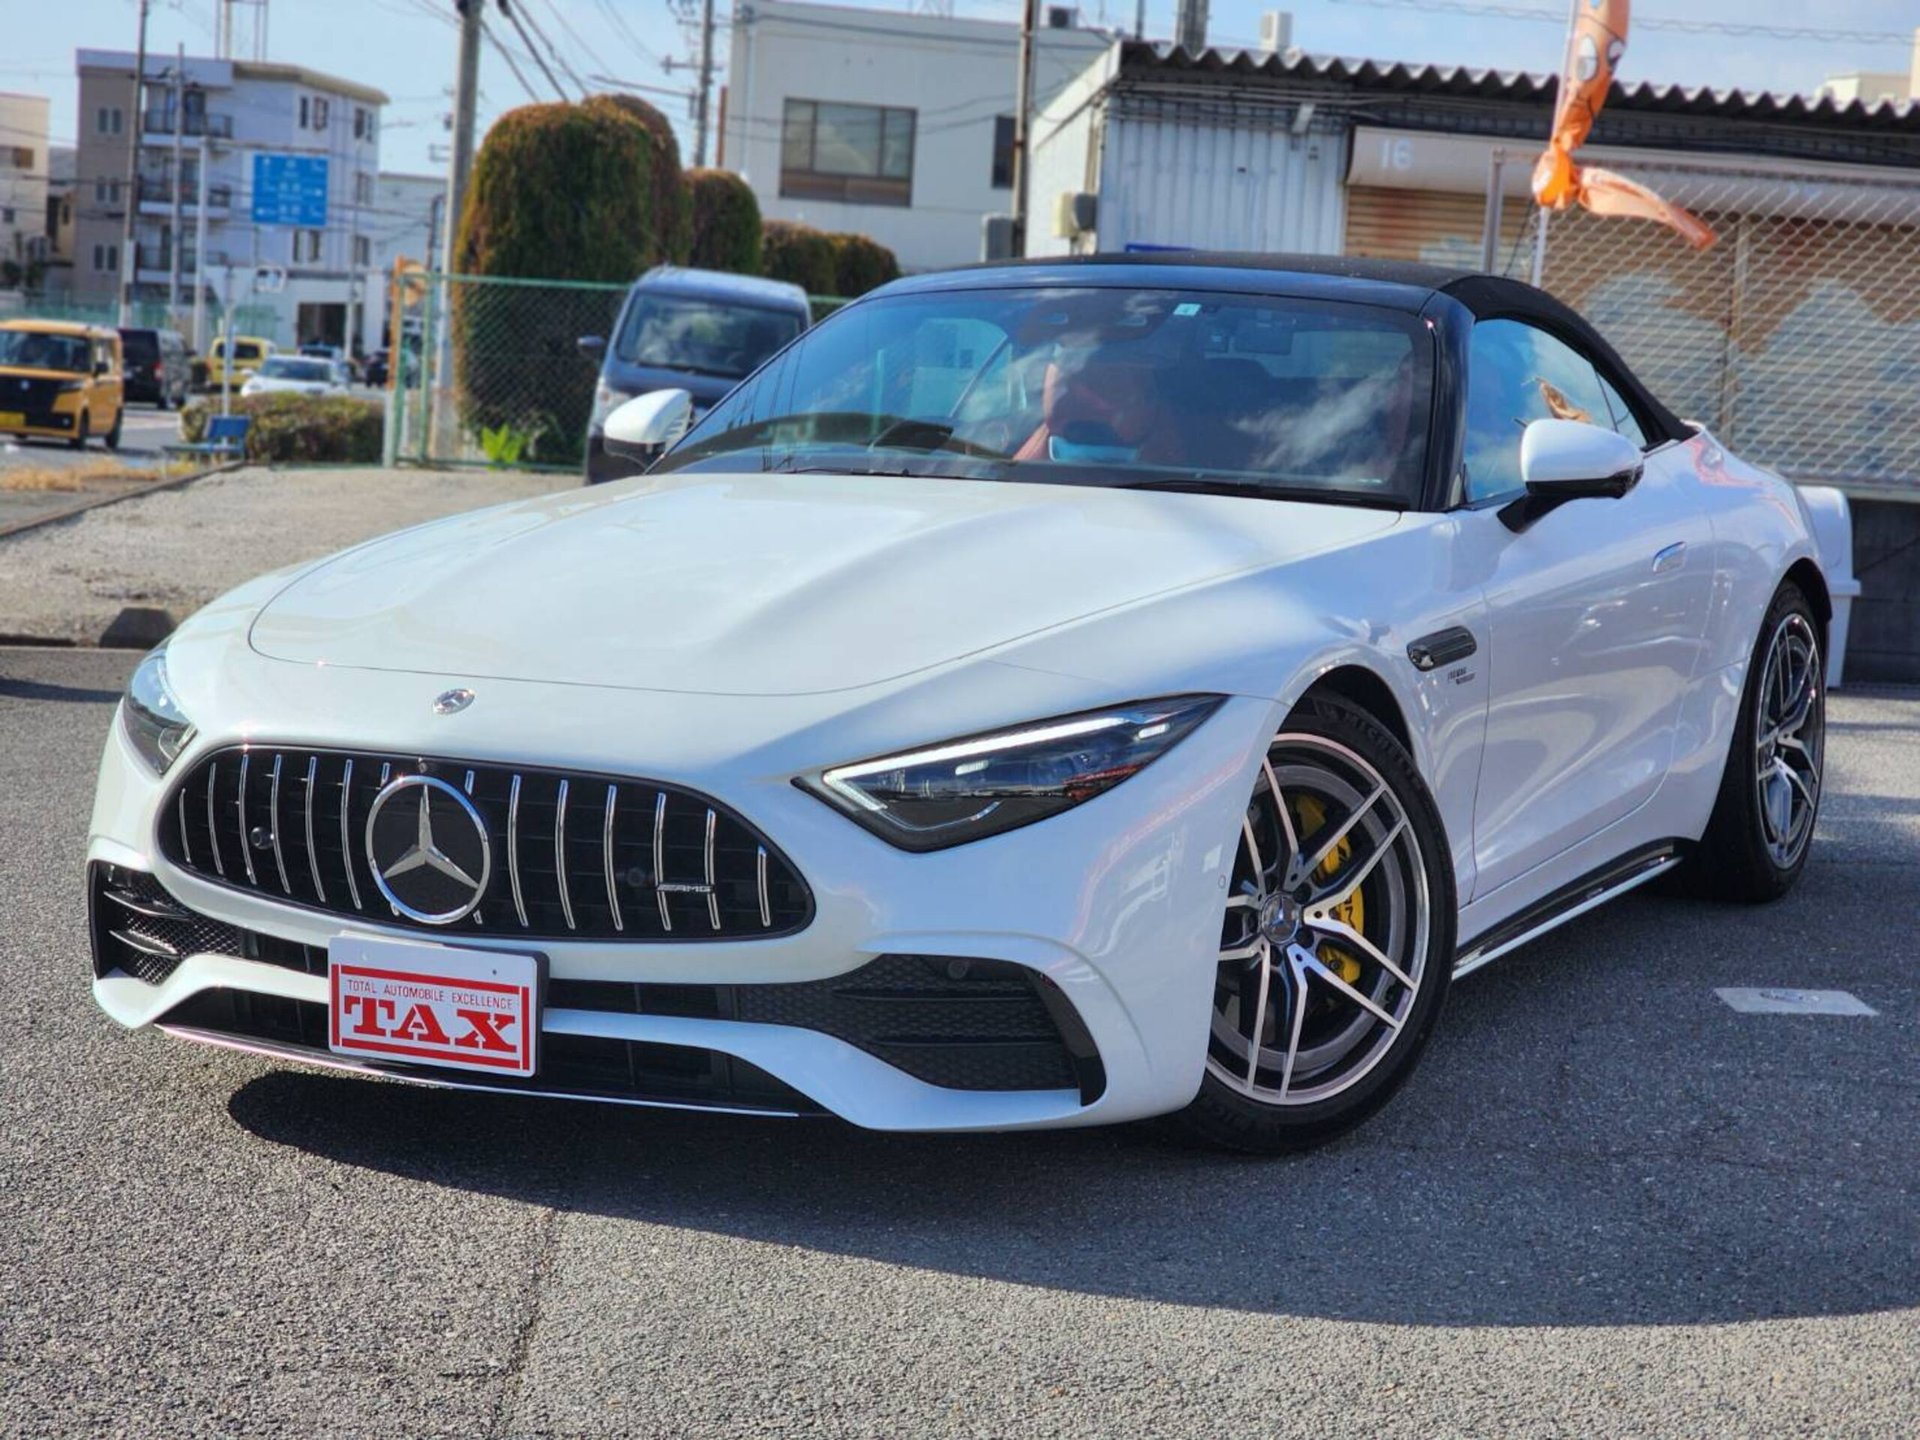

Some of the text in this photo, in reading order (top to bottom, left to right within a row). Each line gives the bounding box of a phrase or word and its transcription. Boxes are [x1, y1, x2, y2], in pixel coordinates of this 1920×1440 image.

[347, 979, 513, 1009] TOTAL AUTOMOBILE EXCELLENCE
[344, 995, 517, 1053] TAX
